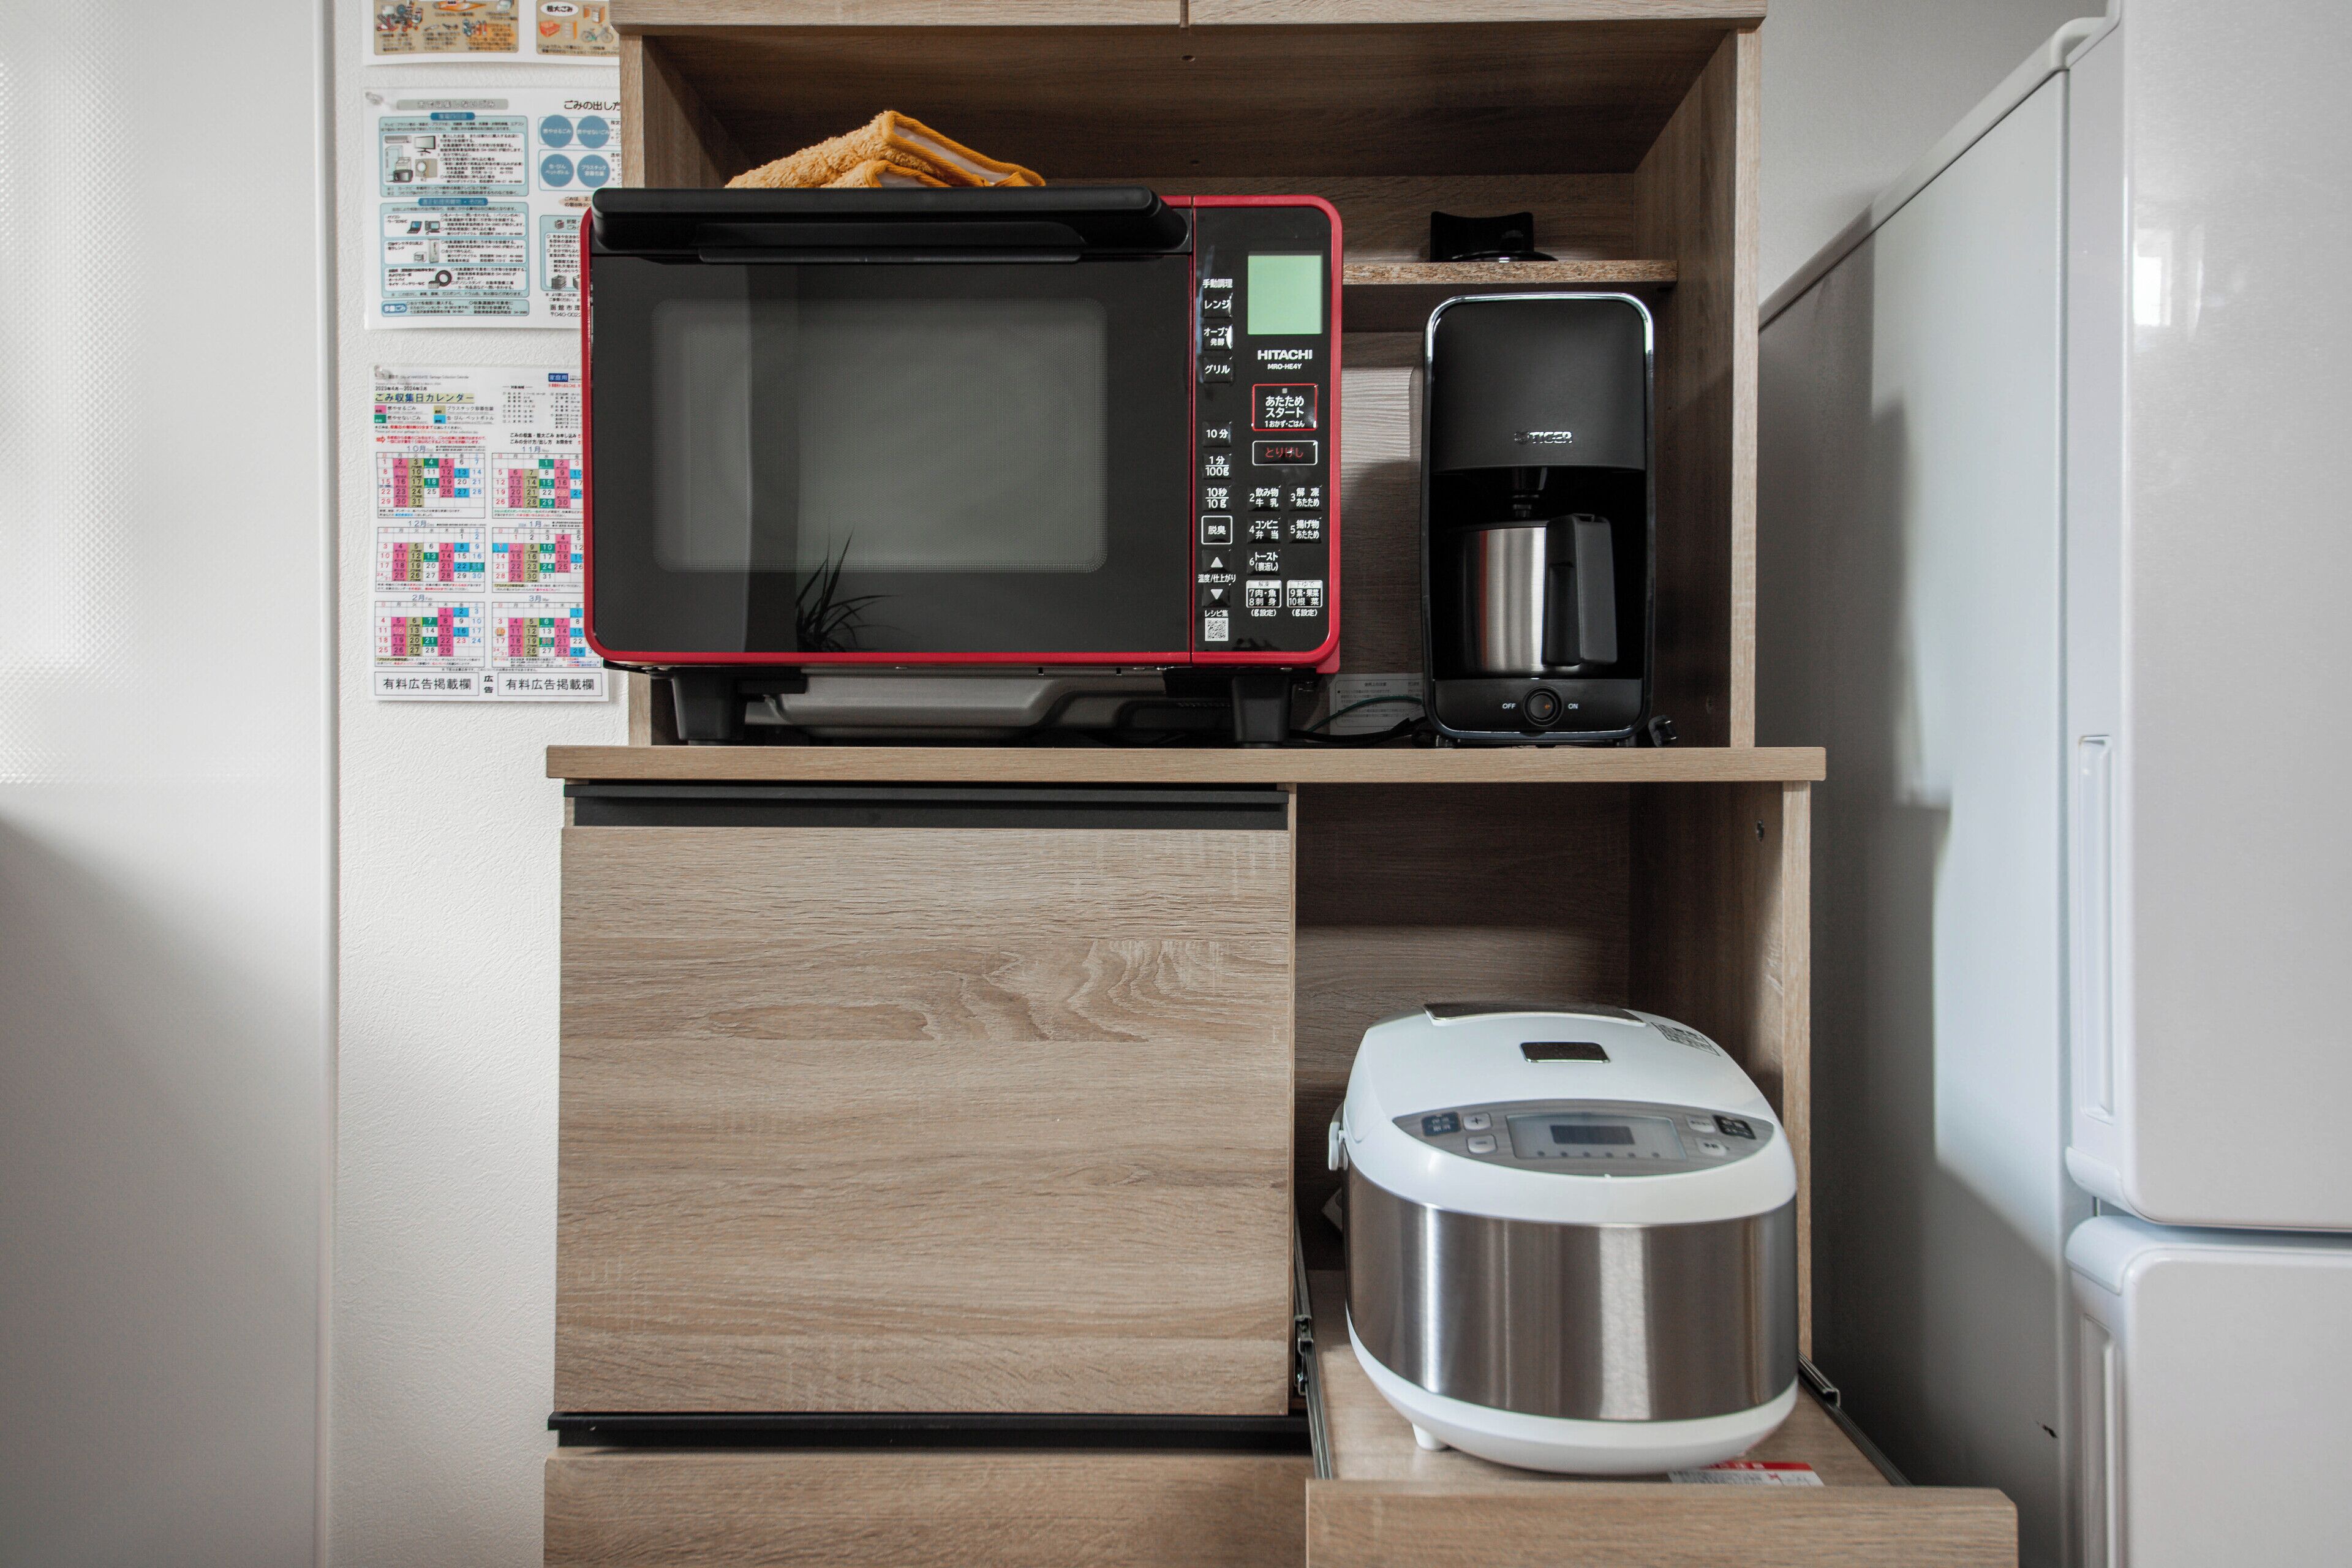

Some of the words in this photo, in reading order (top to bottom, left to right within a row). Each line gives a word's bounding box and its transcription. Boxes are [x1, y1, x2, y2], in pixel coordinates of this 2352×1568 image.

[1202, 279, 1233, 288] 手動調理
[1204, 300, 1231, 309] レンジ
[1257, 350, 1313, 360] HITACHI
[1205, 364, 1230, 374] グリル
[375, 393, 473, 402] ごみ収集日カレンダー
[1265, 396, 1304, 407] あたため
[1265, 407, 1304, 418] スタート
[1529, 431, 1572, 443] TIGER
[1265, 447, 1303, 458] とりけし
[1205, 467, 1229, 477] 100g
[1296, 520, 1320, 529] 揚げ物
[1208, 526, 1226, 535] 脱臭
[1296, 530, 1319, 539] あたため
[1255, 552, 1278, 560] トースト
[1198, 574, 1236, 582] 温度/仕上がり
[383, 678, 472, 690] 有料広告掲載欄
[484, 676, 494, 694] 広告
[506, 678, 595, 690] 有料広告掲載欄
